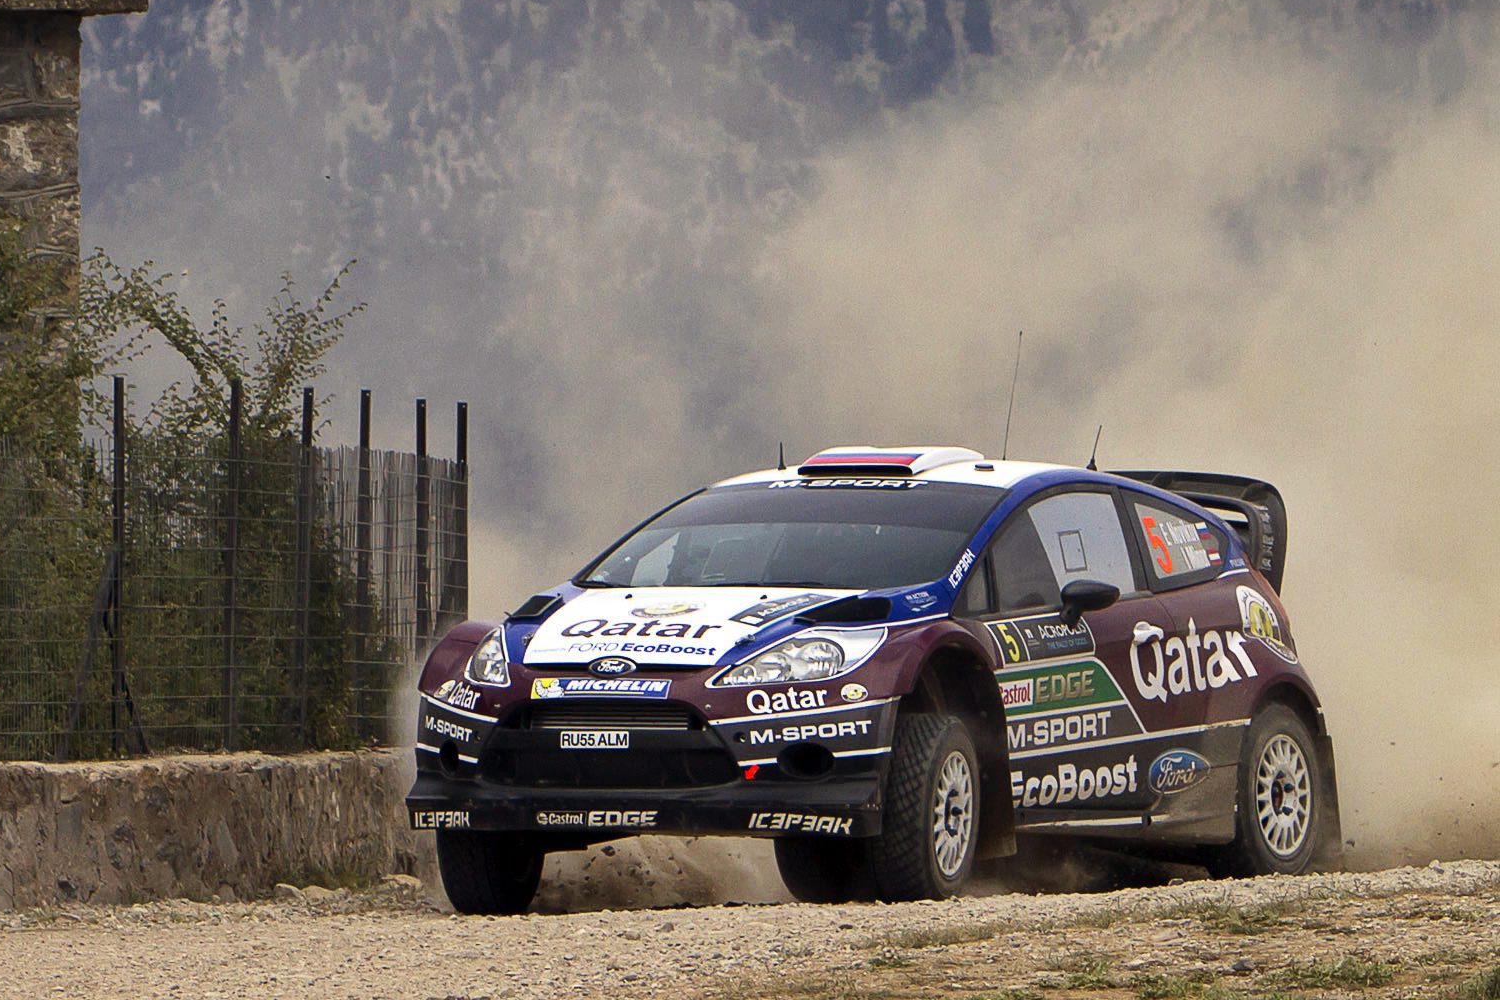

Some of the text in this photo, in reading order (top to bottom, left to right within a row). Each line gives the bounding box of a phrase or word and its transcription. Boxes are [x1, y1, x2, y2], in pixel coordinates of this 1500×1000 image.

[768, 478, 928, 489] M-SPORT
[1141, 515, 1173, 574] 5
[561, 619, 722, 639] Qatar
[996, 623, 1020, 662] 5
[568, 642, 620, 653] FORD
[620, 642, 717, 656] EcoBoost
[1129, 616, 1259, 704] Qatar
[596, 659, 626, 674] Ford
[448, 680, 481, 710] Qatar
[566, 679, 668, 692] MICHELIN
[1036, 669, 1095, 703] EDGE
[746, 686, 828, 714] Qatar
[425, 715, 472, 742] M-SPORT
[561, 732, 628, 747] RU55 ALM
[750, 719, 872, 745] M-SPORT
[1006, 710, 1112, 750] M-SPORT
[1010, 754, 1138, 808] EcoBoost
[1156, 756, 1197, 787] Ford
[548, 810, 658, 827] Castrol EDGE
